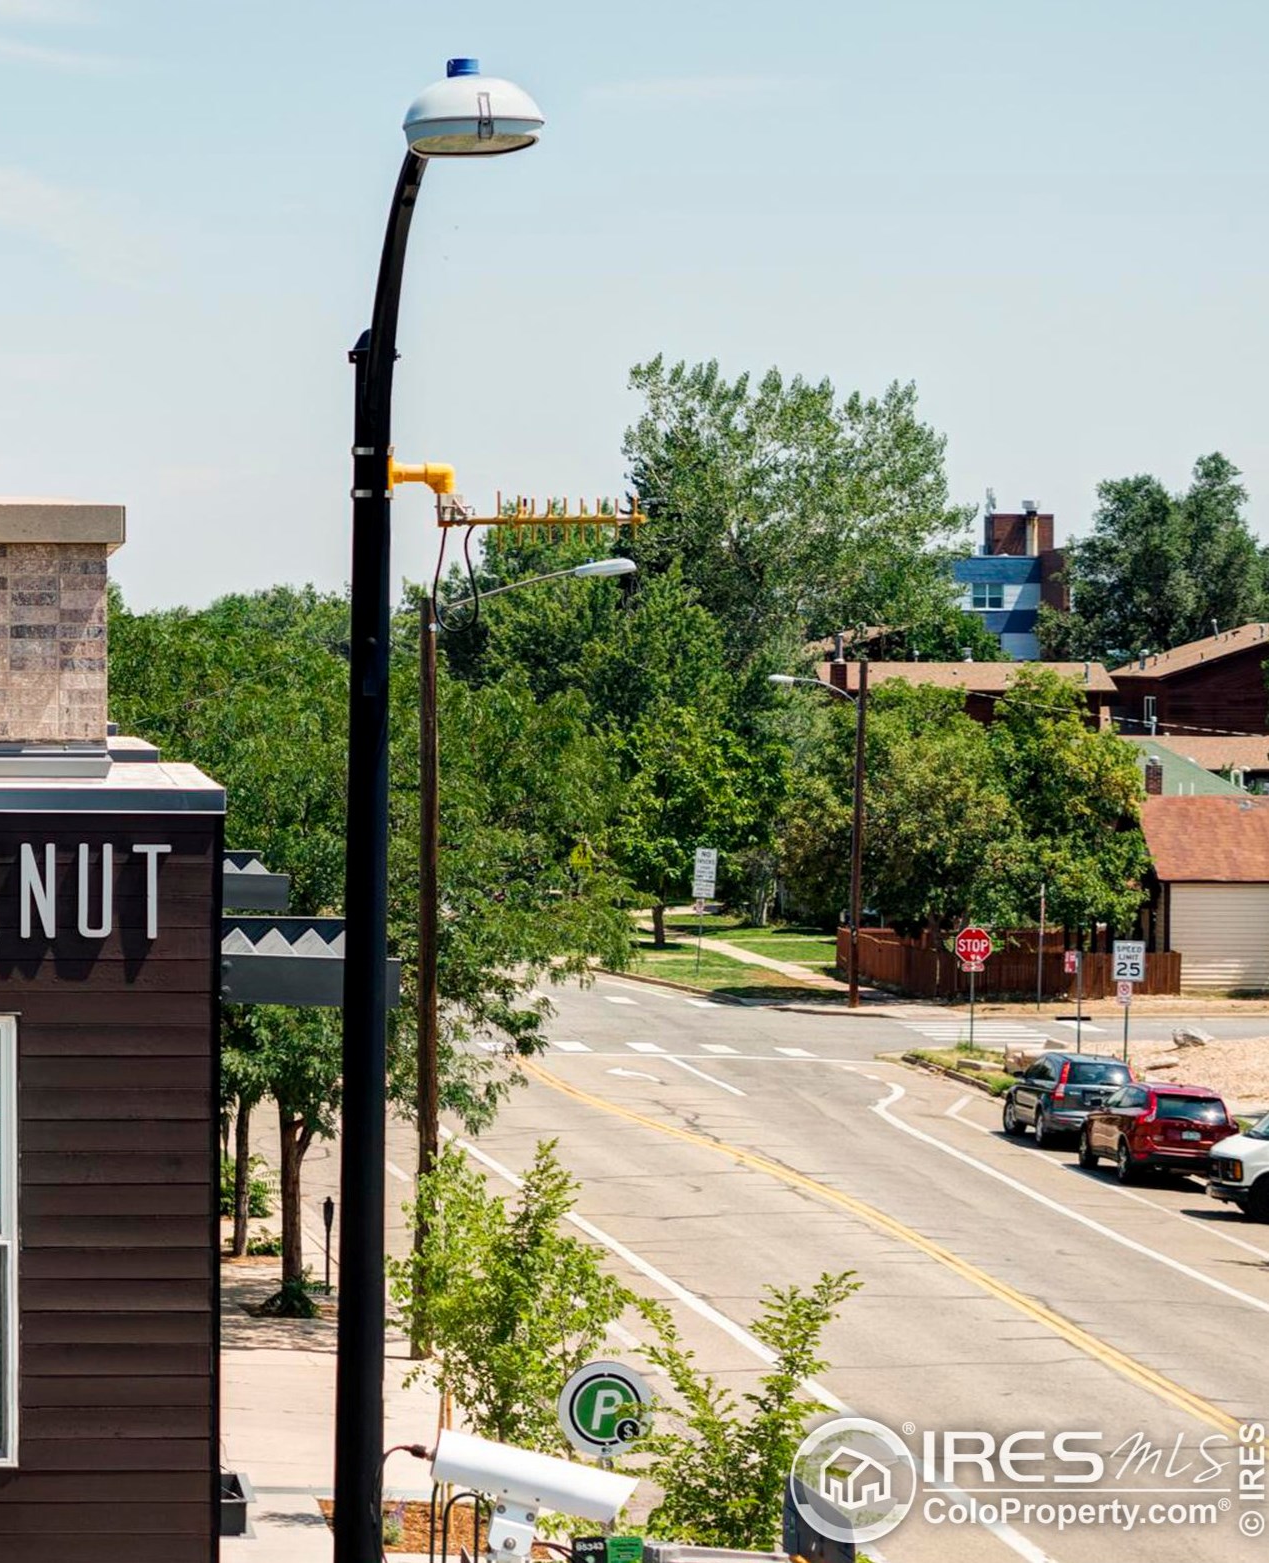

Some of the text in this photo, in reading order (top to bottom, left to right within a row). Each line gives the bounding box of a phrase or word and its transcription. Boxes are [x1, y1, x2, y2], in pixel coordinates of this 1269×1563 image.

[958, 938, 988, 952] STOP
[1116, 945, 1142, 953] SPEED
[1116, 962, 1141, 976] 25
[591, 1389, 623, 1430] P
